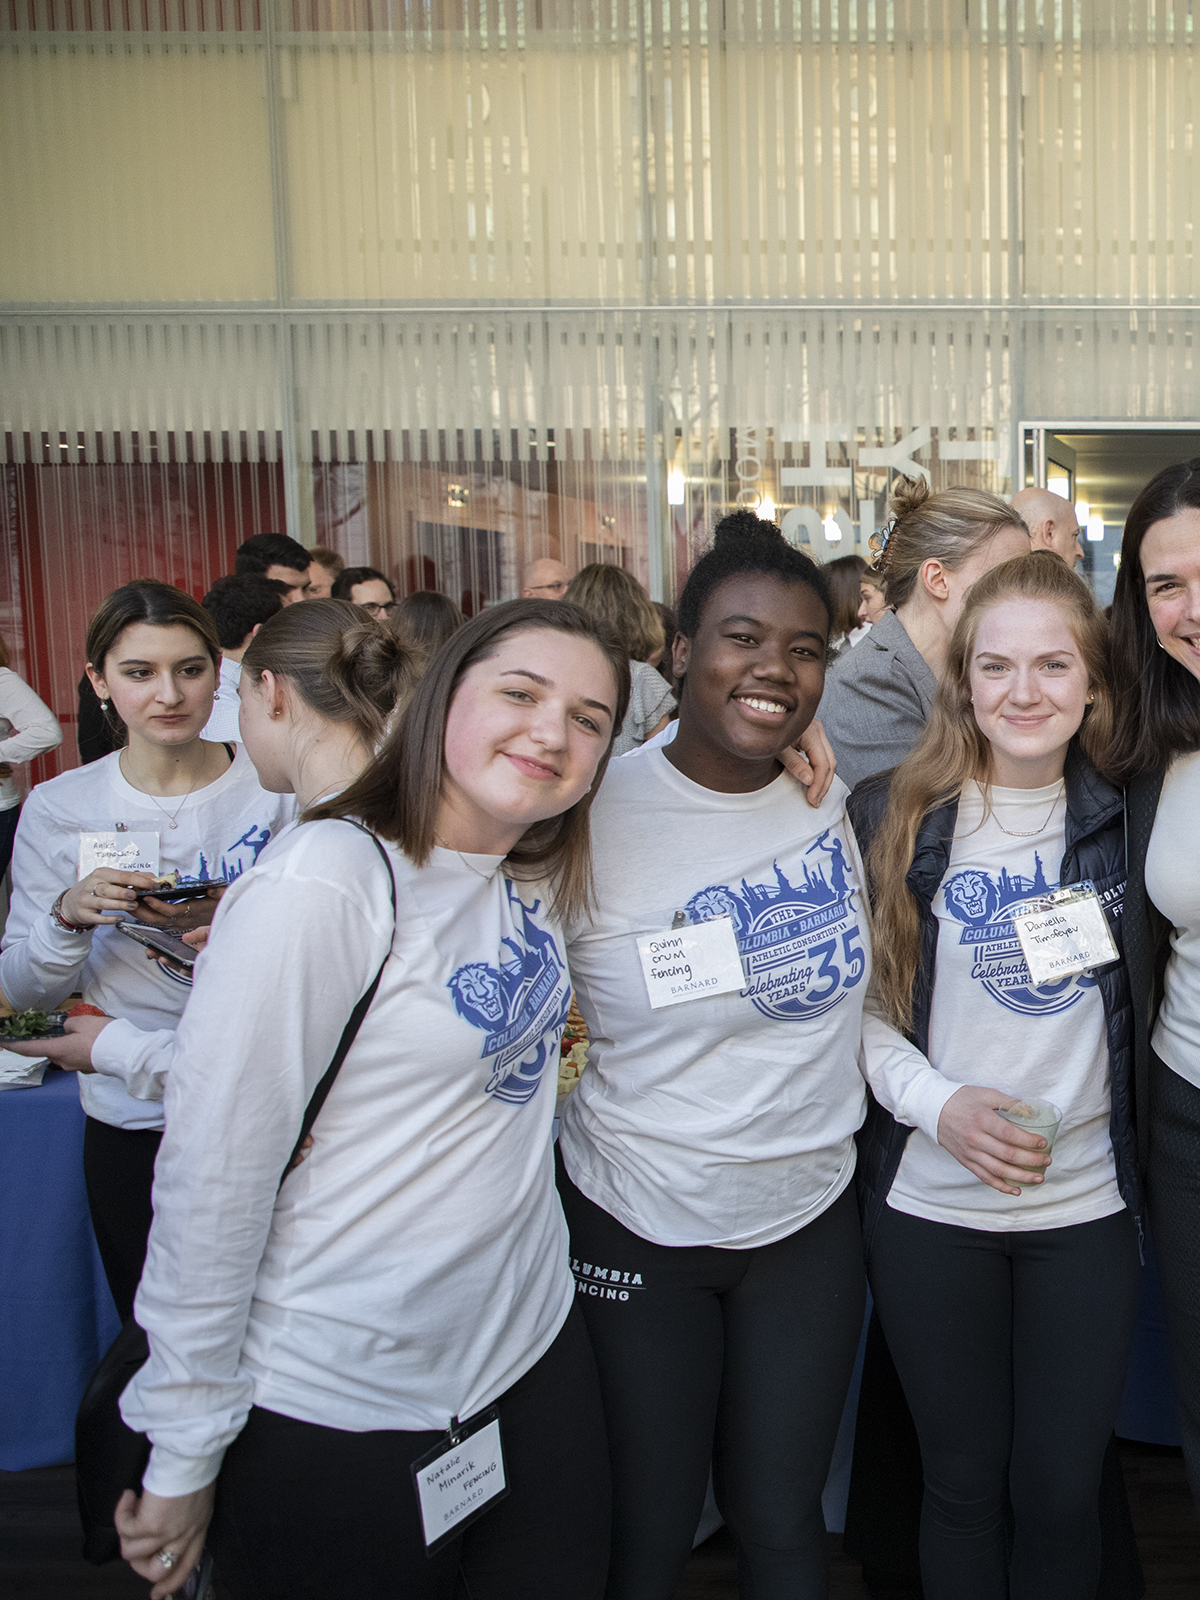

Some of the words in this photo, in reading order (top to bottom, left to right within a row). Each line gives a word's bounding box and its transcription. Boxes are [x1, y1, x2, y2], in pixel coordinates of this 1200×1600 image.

[771, 909, 795, 924] THE
[799, 903, 846, 931] BARNARD
[1024, 915, 1067, 932] Daniella
[649, 937, 684, 953] Quinn
[752, 945, 791, 963] ATHLETIC
[792, 927, 839, 951] CONSORTIUM
[805, 925, 866, 1002] 35
[1049, 951, 1091, 969] BARNARD
[530, 965, 558, 1010] BARNARD
[671, 977, 719, 995] BARNARD
[767, 982, 806, 1003] YEARS
[568, 1257, 643, 1285] LUMBIA
[426, 1456, 461, 1485] Natalie
[438, 1461, 476, 1492] Minarik
[444, 1487, 484, 1521] BARNARD
